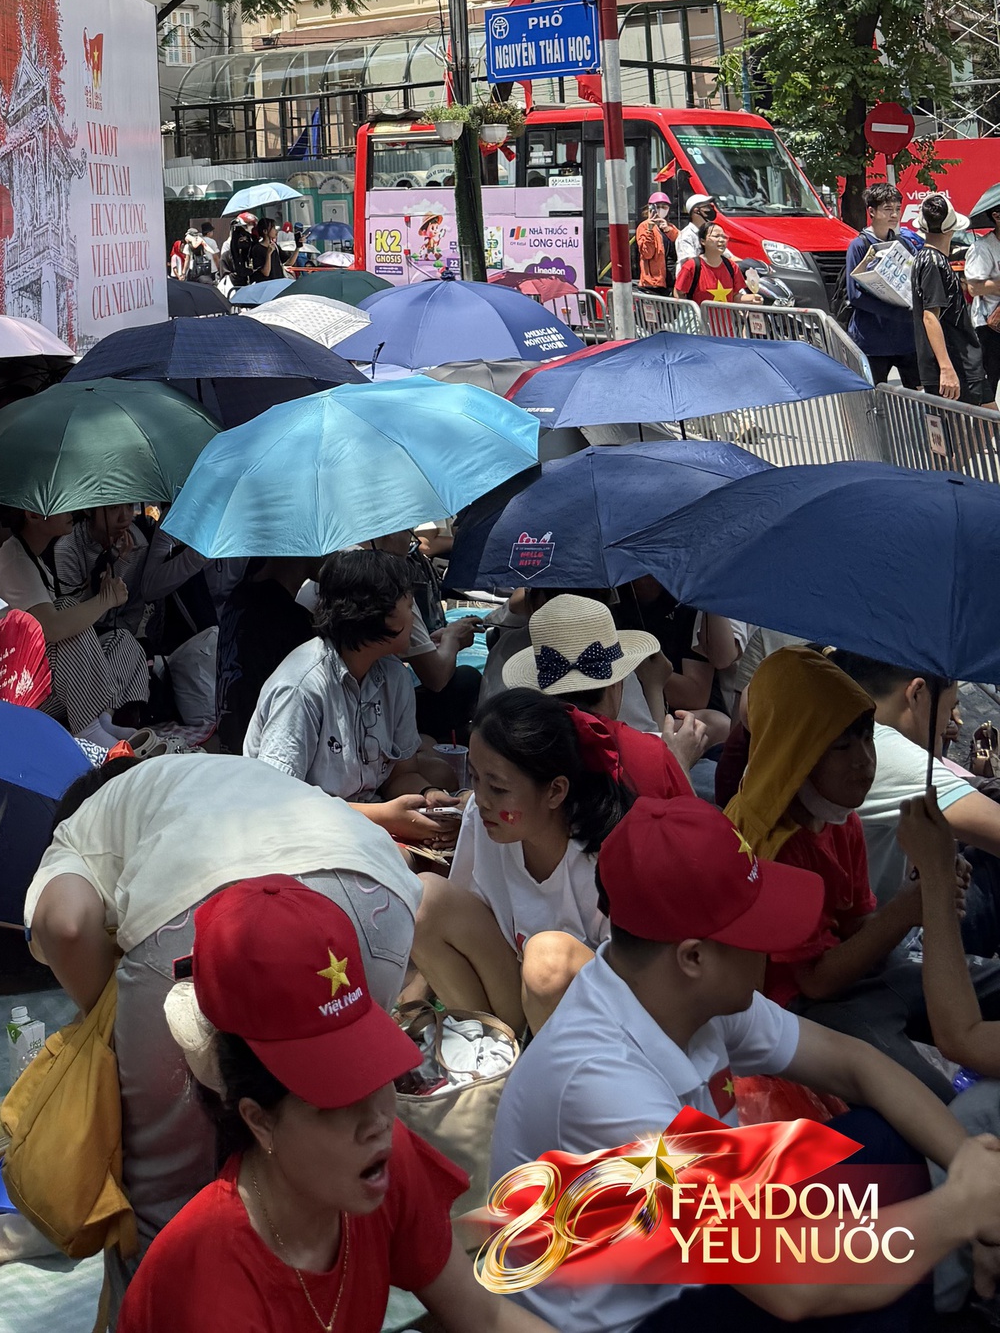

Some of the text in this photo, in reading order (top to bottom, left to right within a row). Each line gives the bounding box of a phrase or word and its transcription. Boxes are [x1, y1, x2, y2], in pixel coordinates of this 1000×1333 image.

[528, 7, 563, 29] PHỐ
[495, 33, 591, 69] NGUYỄN THÁI HỌC
[111, 164, 131, 196] NAM
[375, 229, 401, 253] K2
[529, 225, 568, 235] NHÀ THUỐC
[529, 237, 579, 248] LONG CHÂU
[375, 254, 402, 264] GNOSIS
[884, 256, 908, 284] true
[319, 986, 363, 1017] Việt Nam
